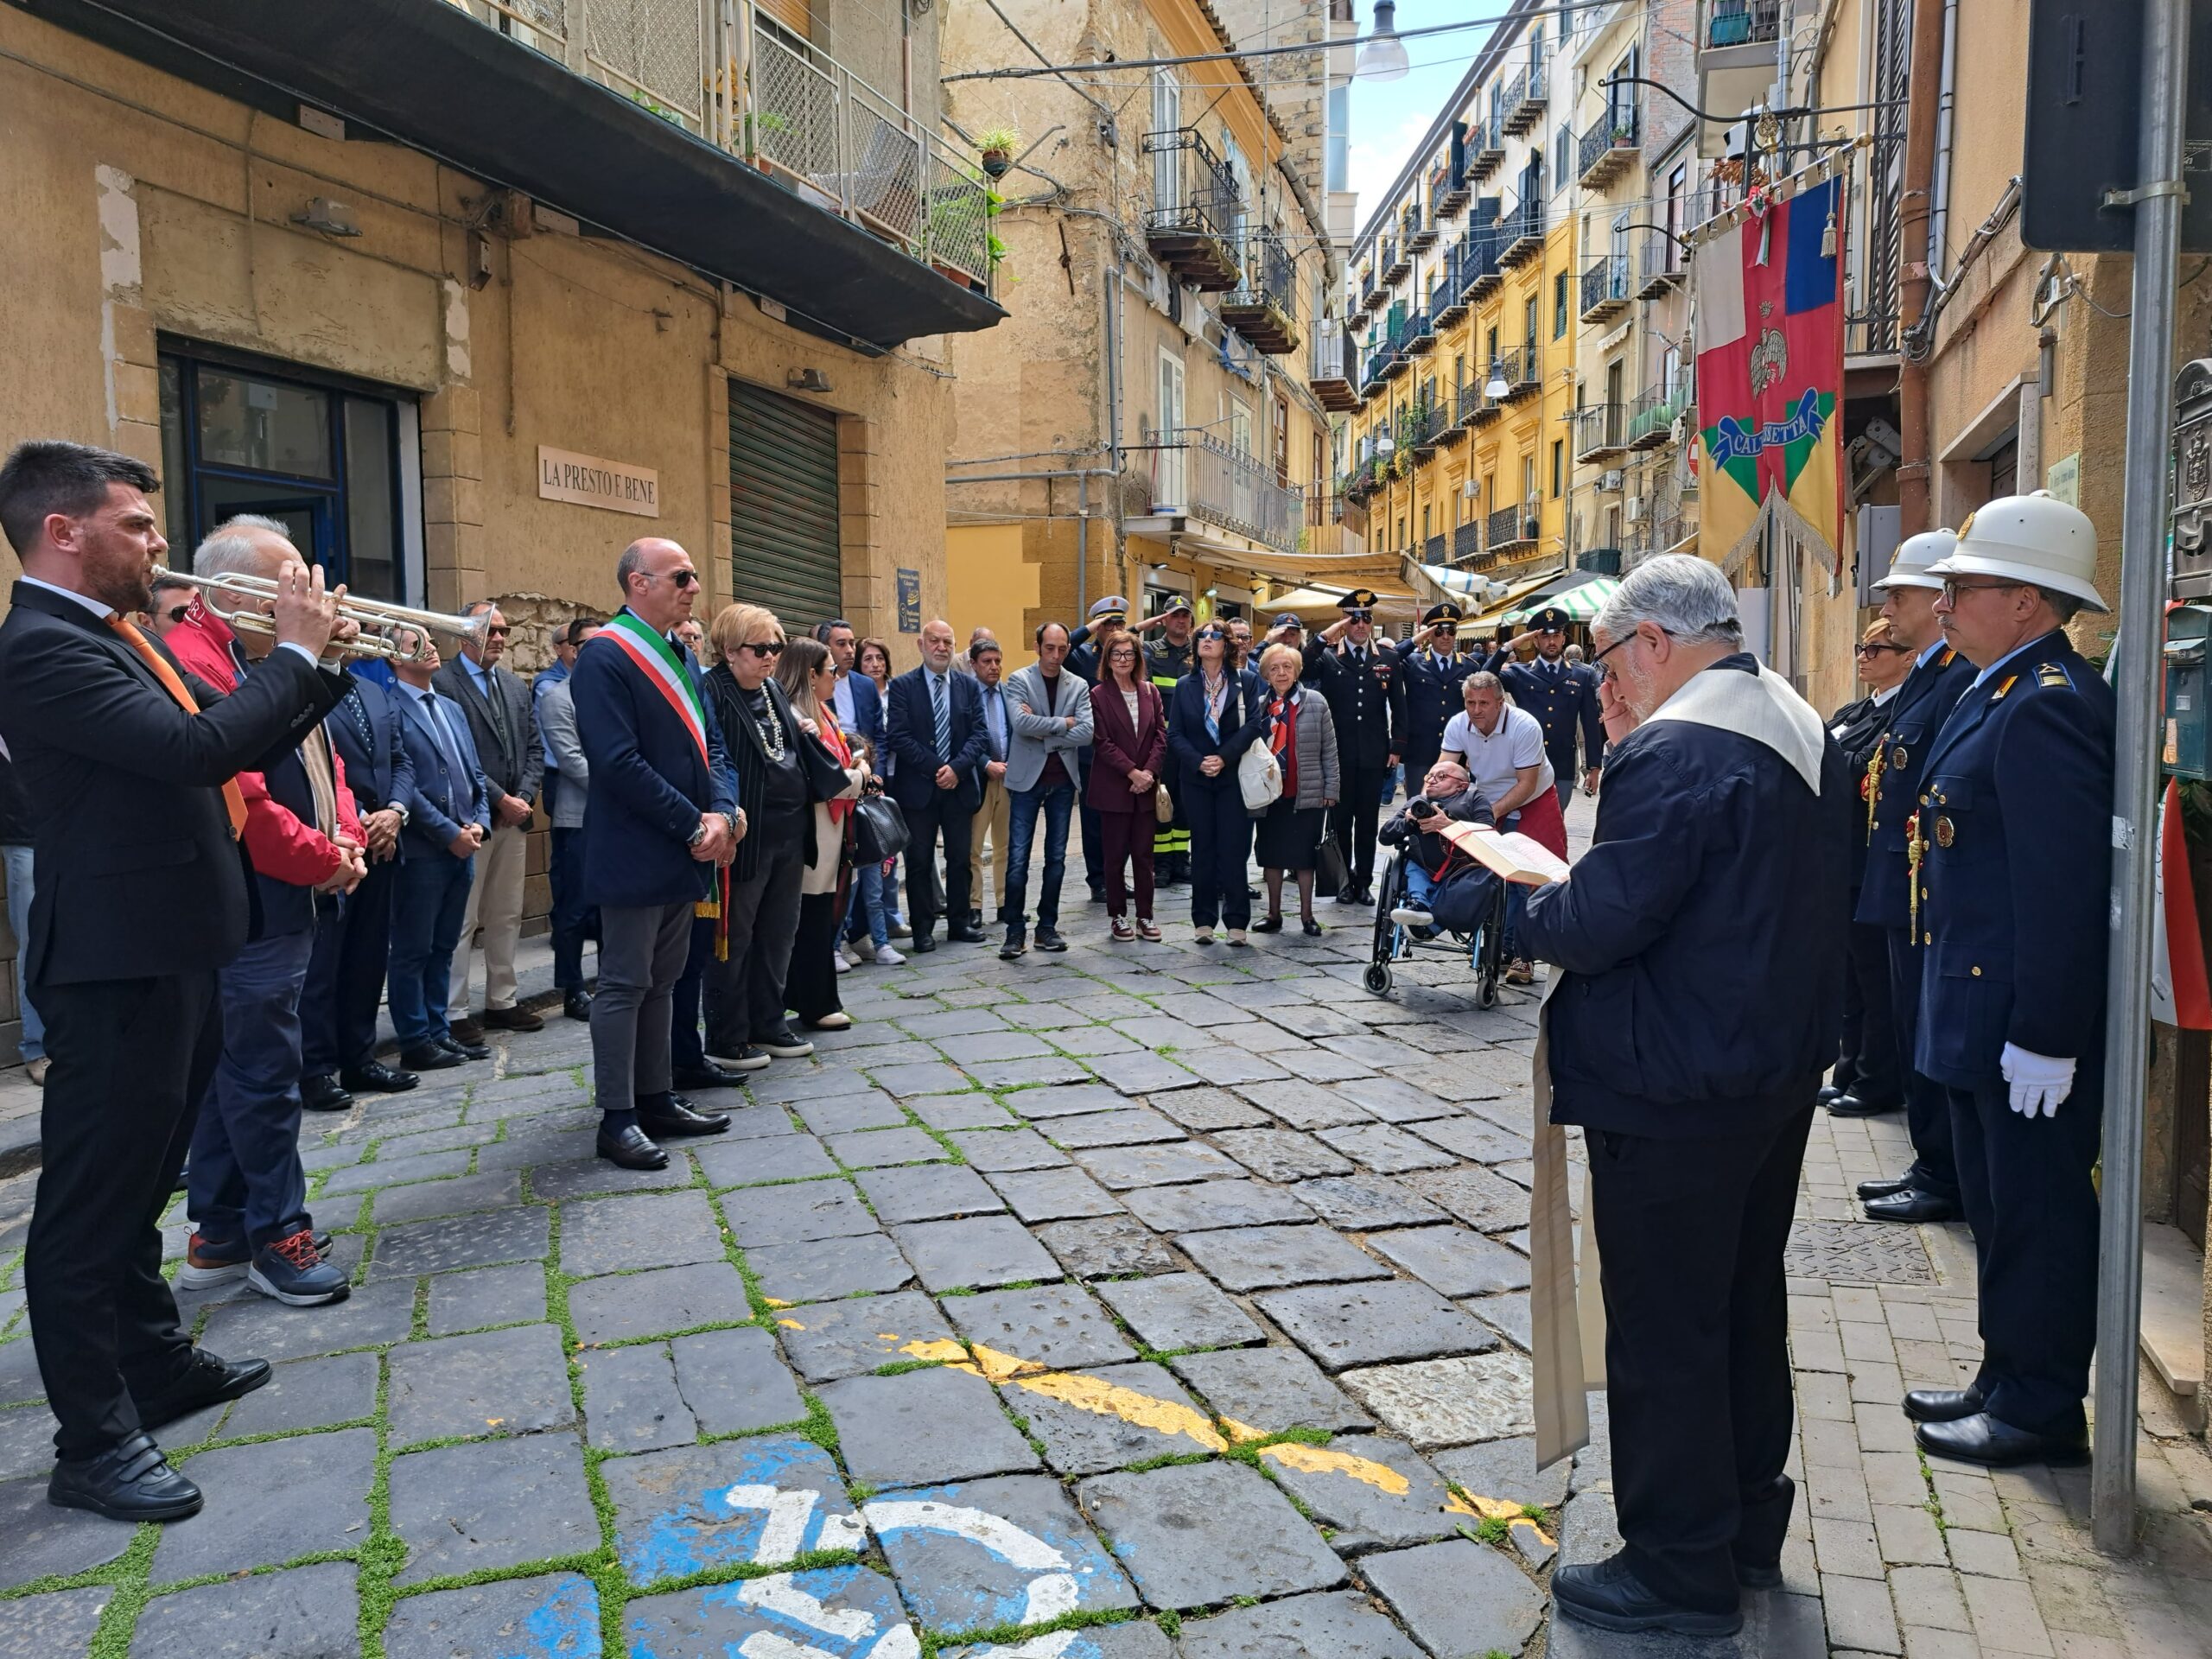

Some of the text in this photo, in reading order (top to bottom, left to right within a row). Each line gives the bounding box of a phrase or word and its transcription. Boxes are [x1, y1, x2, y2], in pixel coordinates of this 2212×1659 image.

[1734, 415, 1808, 454] CALSSETTA
[543, 459, 655, 505] LA PRESTO E BENE
